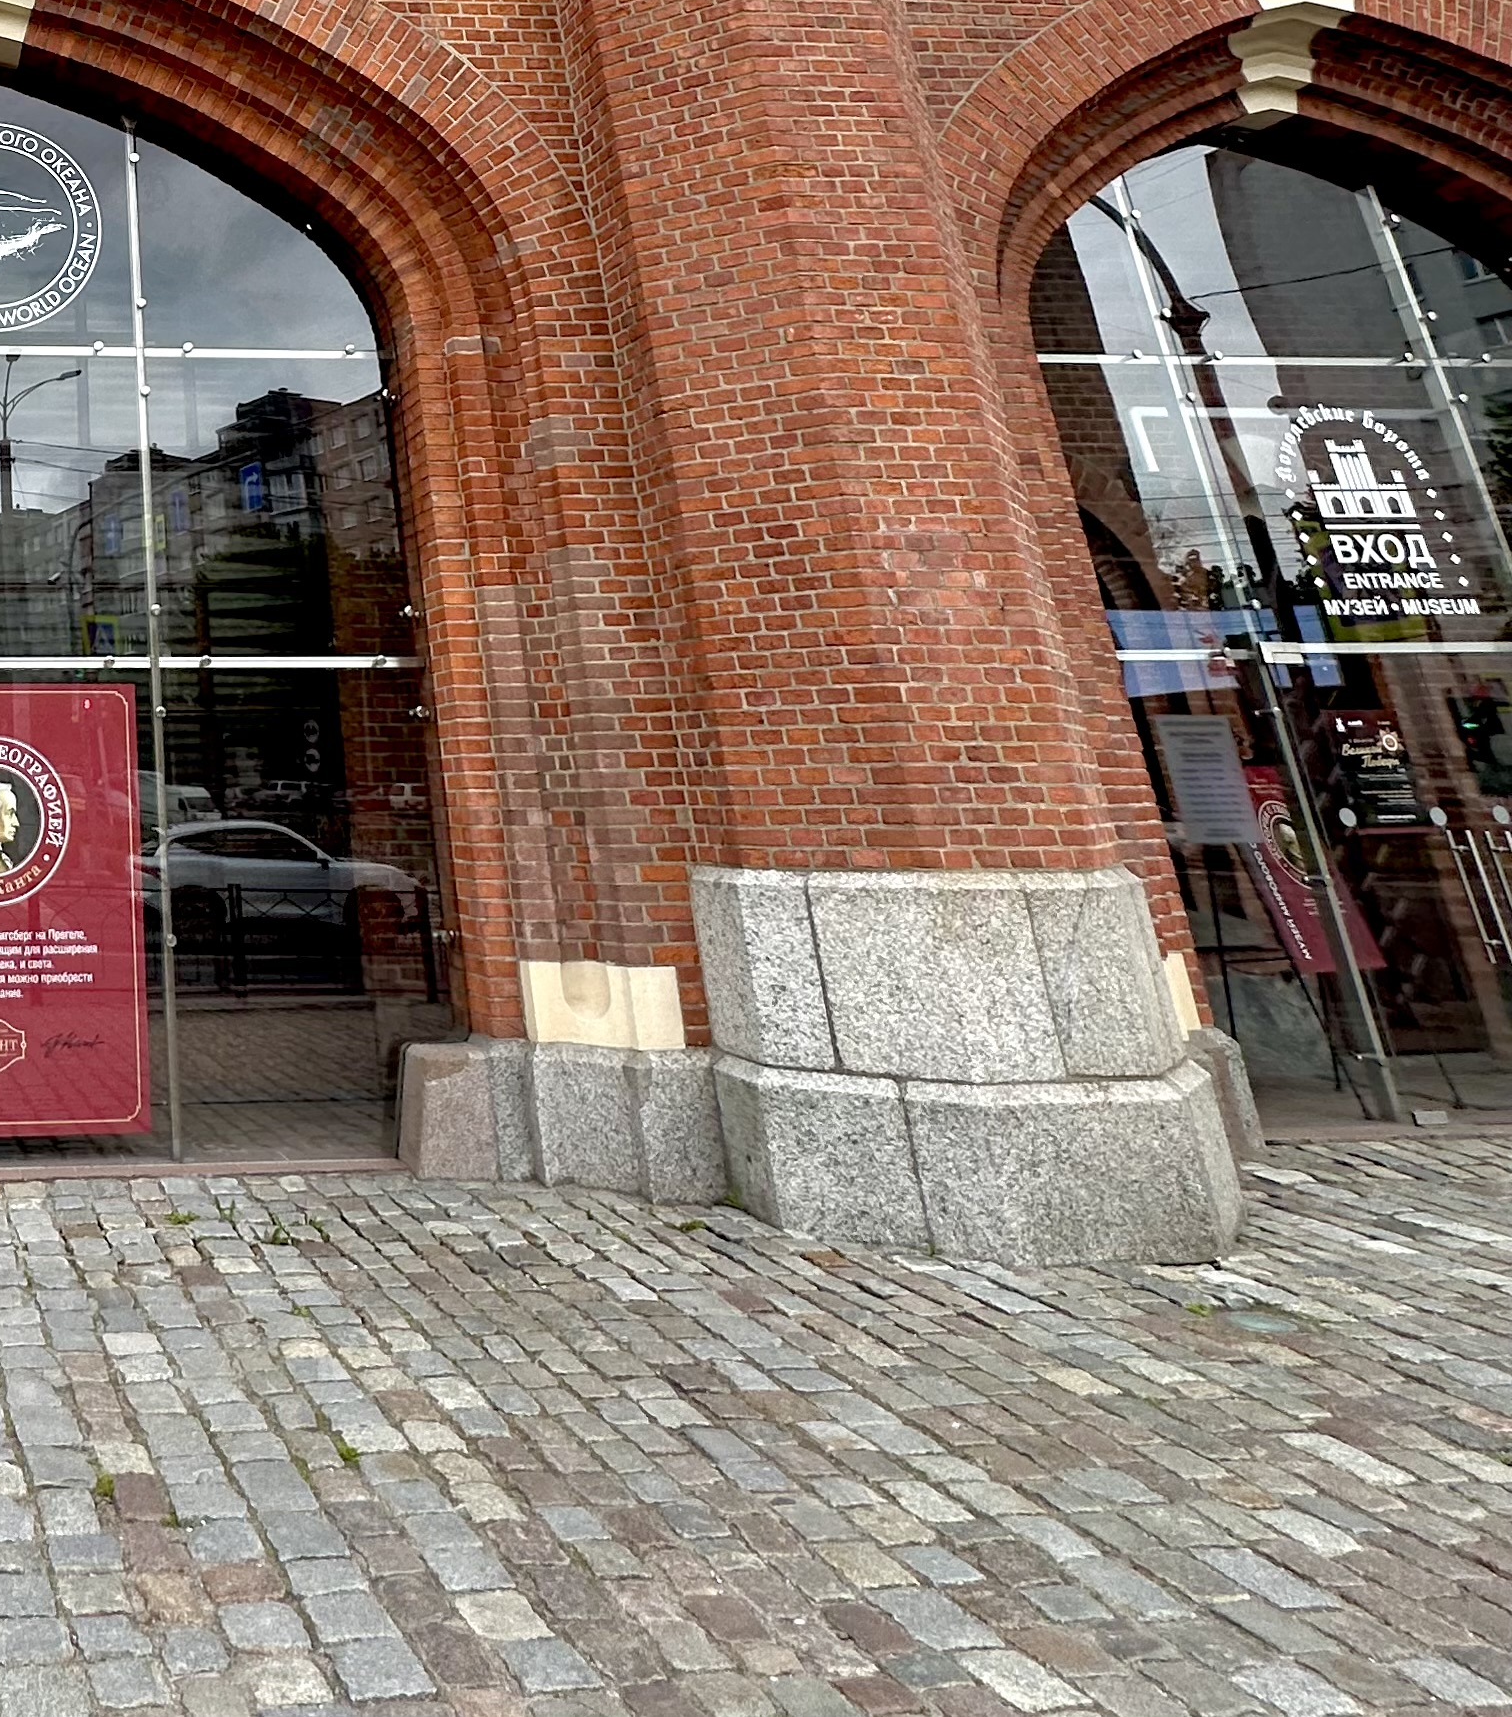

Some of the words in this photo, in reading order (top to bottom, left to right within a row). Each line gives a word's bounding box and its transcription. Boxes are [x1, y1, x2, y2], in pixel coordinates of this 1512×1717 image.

[40, 148, 93, 217] ОКЕАНА
[58, 234, 97, 294] OCEAN
[1329, 534, 1437, 569] ВХОД
[1343, 572, 1444, 589] ENTRANCE
[1323, 595, 1389, 615] МУЗЕЙ
[1402, 598, 1481, 615] MUSEUM
[24, 945, 40, 957] для
[19, 959, 26, 969] и
[7, 974, 39, 984] можно
